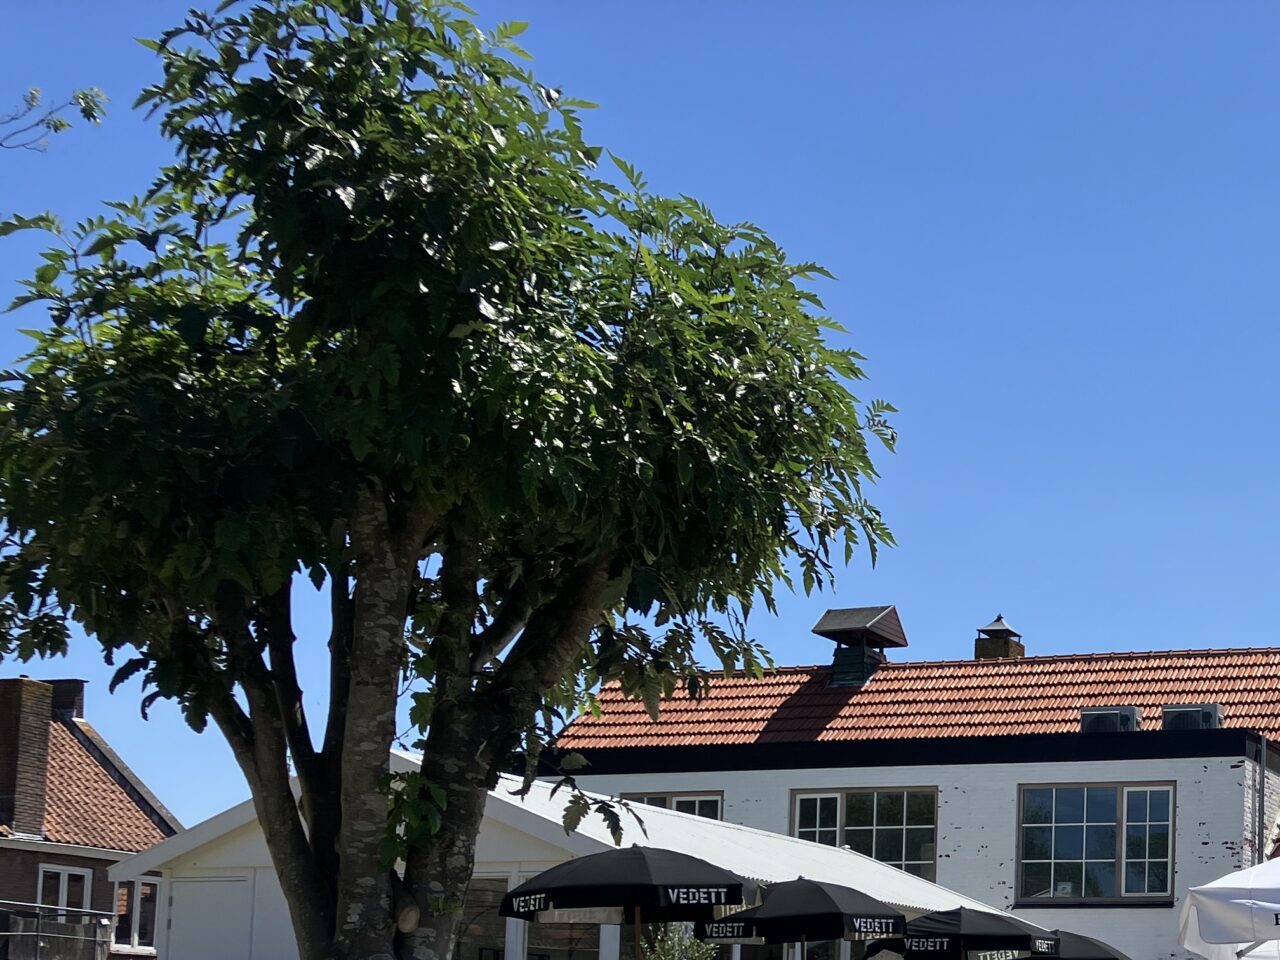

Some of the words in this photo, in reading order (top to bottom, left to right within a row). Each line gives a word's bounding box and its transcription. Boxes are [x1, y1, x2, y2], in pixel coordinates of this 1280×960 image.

[668, 888, 727, 904] VEDETT
[705, 923, 744, 937] VEDETT
[853, 918, 894, 932] VEDETT
[904, 938, 949, 950] VEDETT
